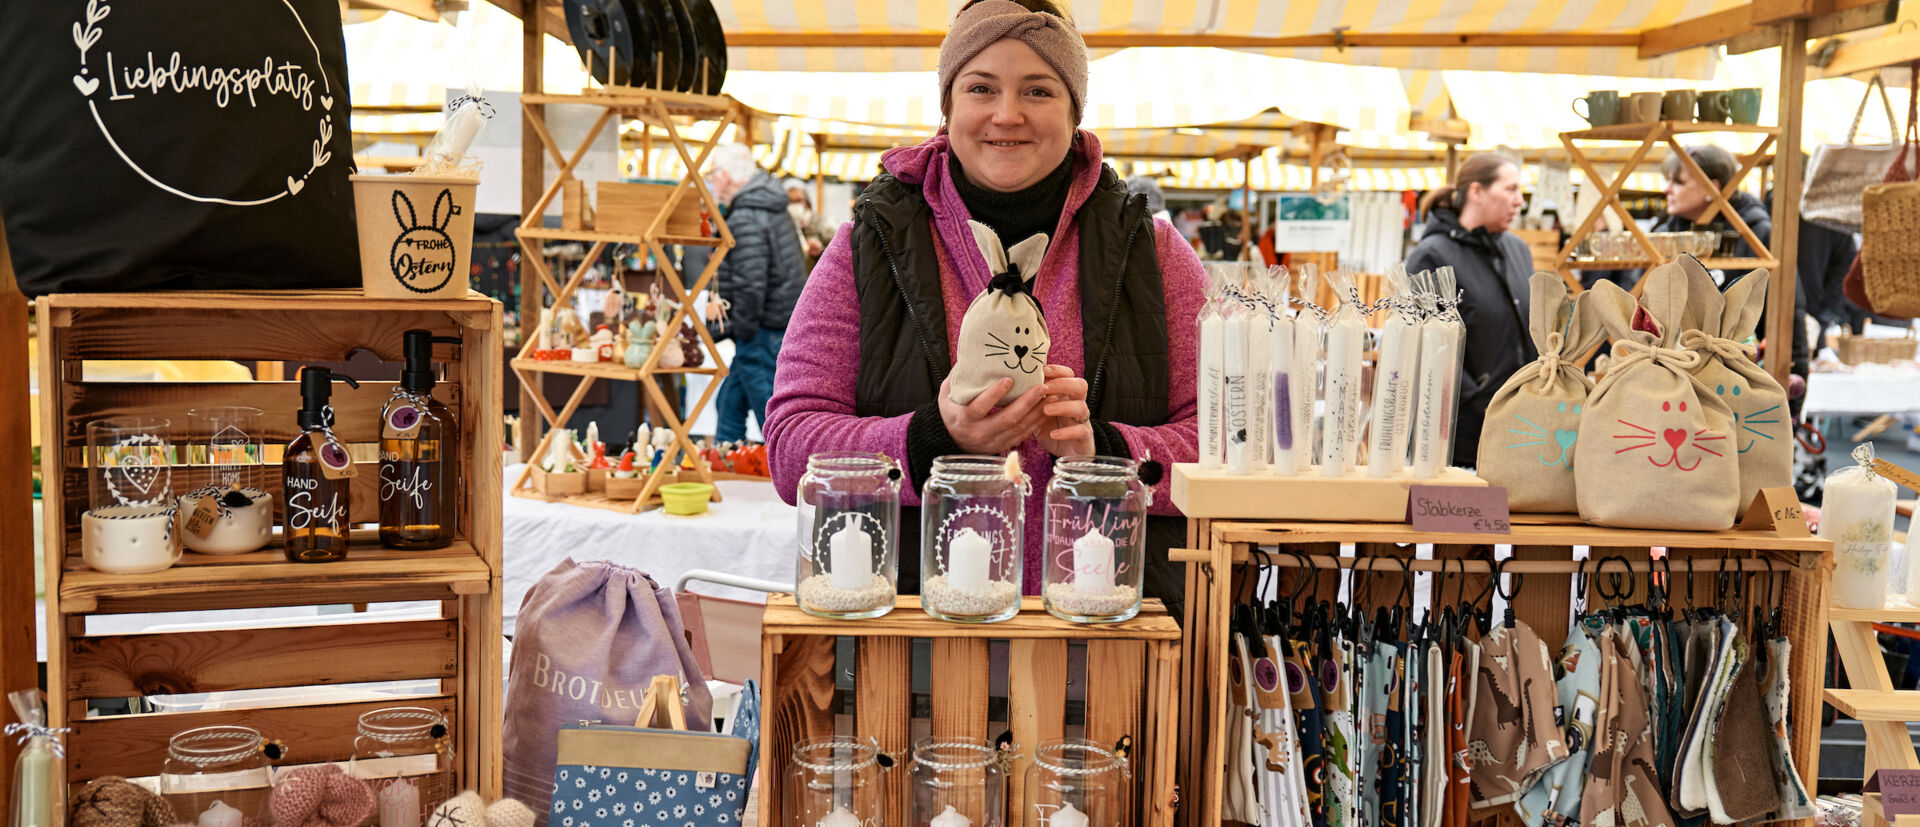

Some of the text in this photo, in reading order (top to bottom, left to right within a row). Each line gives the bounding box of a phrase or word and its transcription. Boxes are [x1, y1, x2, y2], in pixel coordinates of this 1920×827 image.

[107, 51, 315, 111] Lieblingsplatz
[416, 239, 450, 250] FROHE
[396, 253, 452, 281] Ostern
[1229, 375, 1247, 427] OSTERN
[287, 476, 318, 490] HAND
[380, 464, 433, 509] Seife
[289, 491, 347, 536] Seife
[1048, 503, 1142, 546] Frühling
[1115, 537, 1129, 548] DIE
